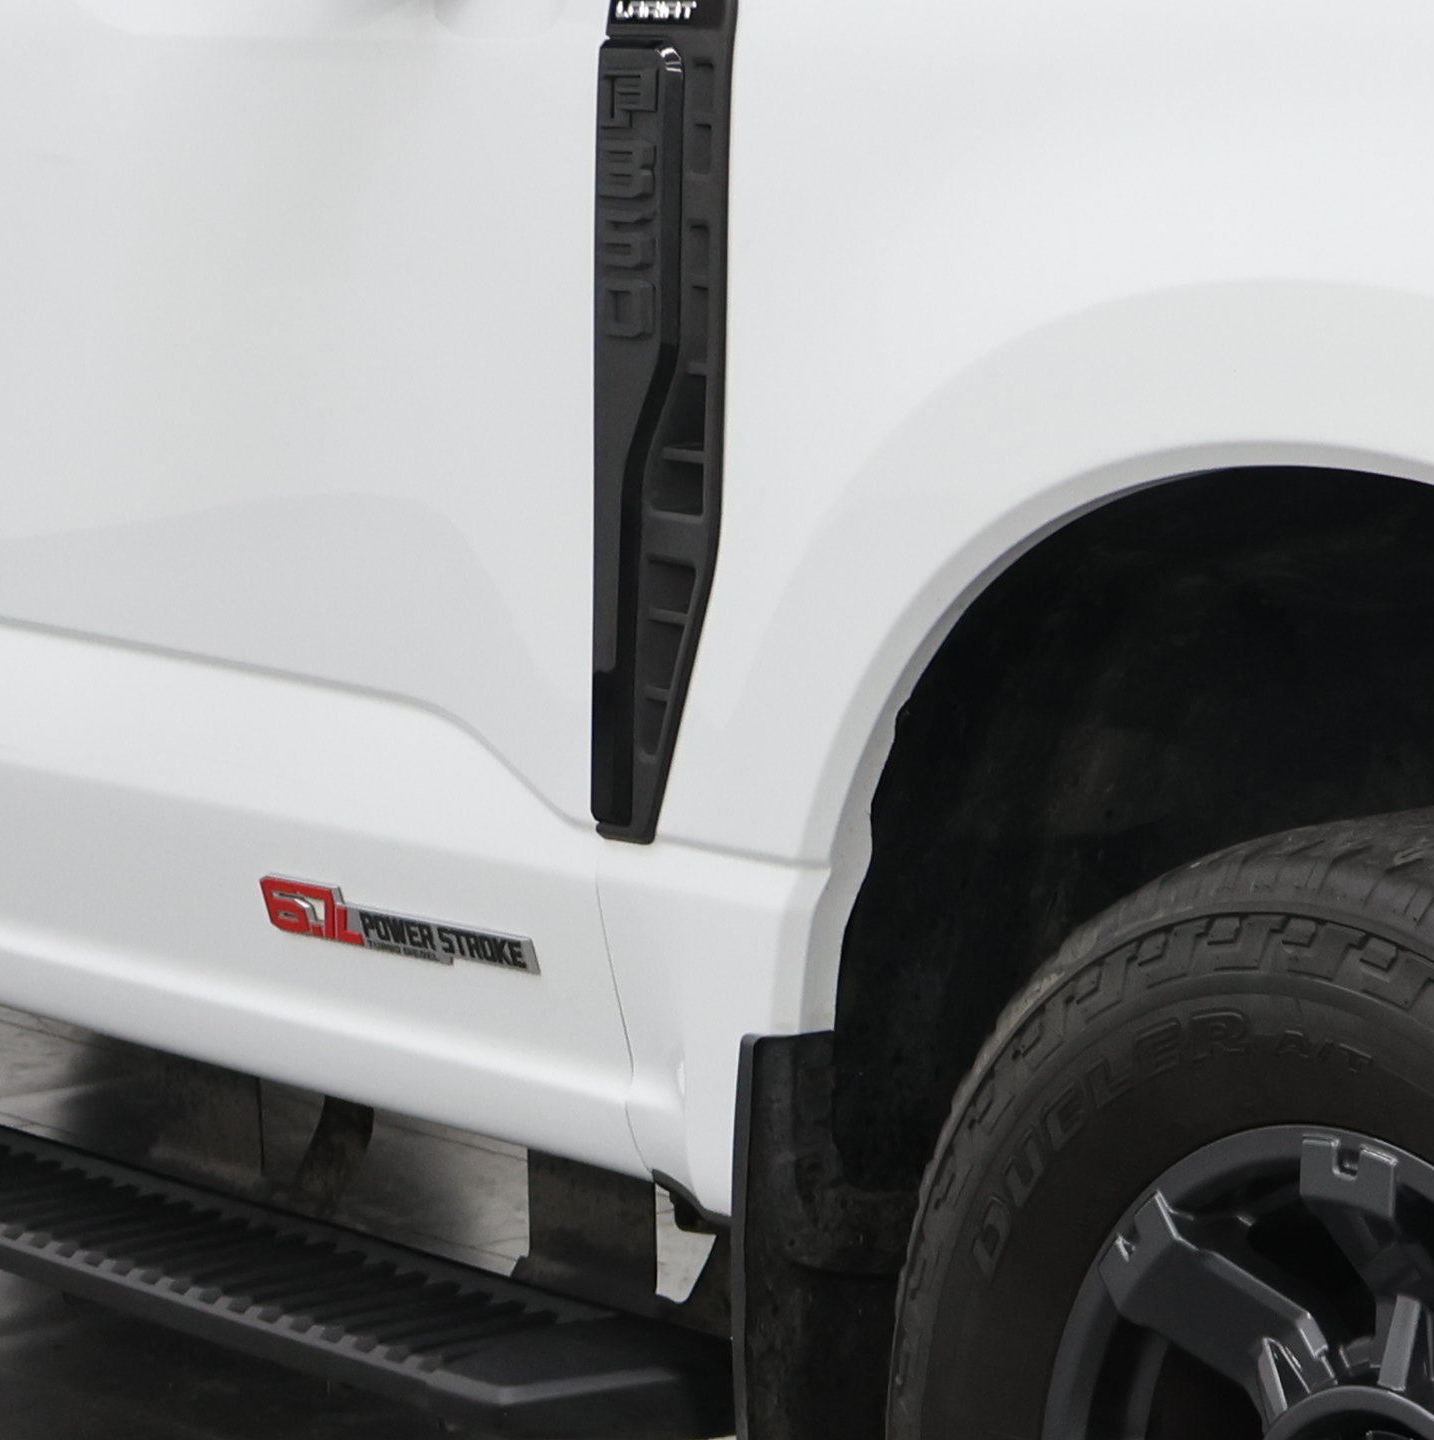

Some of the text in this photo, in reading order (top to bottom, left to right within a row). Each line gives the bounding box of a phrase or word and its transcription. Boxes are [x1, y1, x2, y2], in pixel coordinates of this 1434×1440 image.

[360, 911, 436, 951] POWER
[436, 926, 528, 969] STROKE
[971, 1006, 1251, 1282] DUELER
